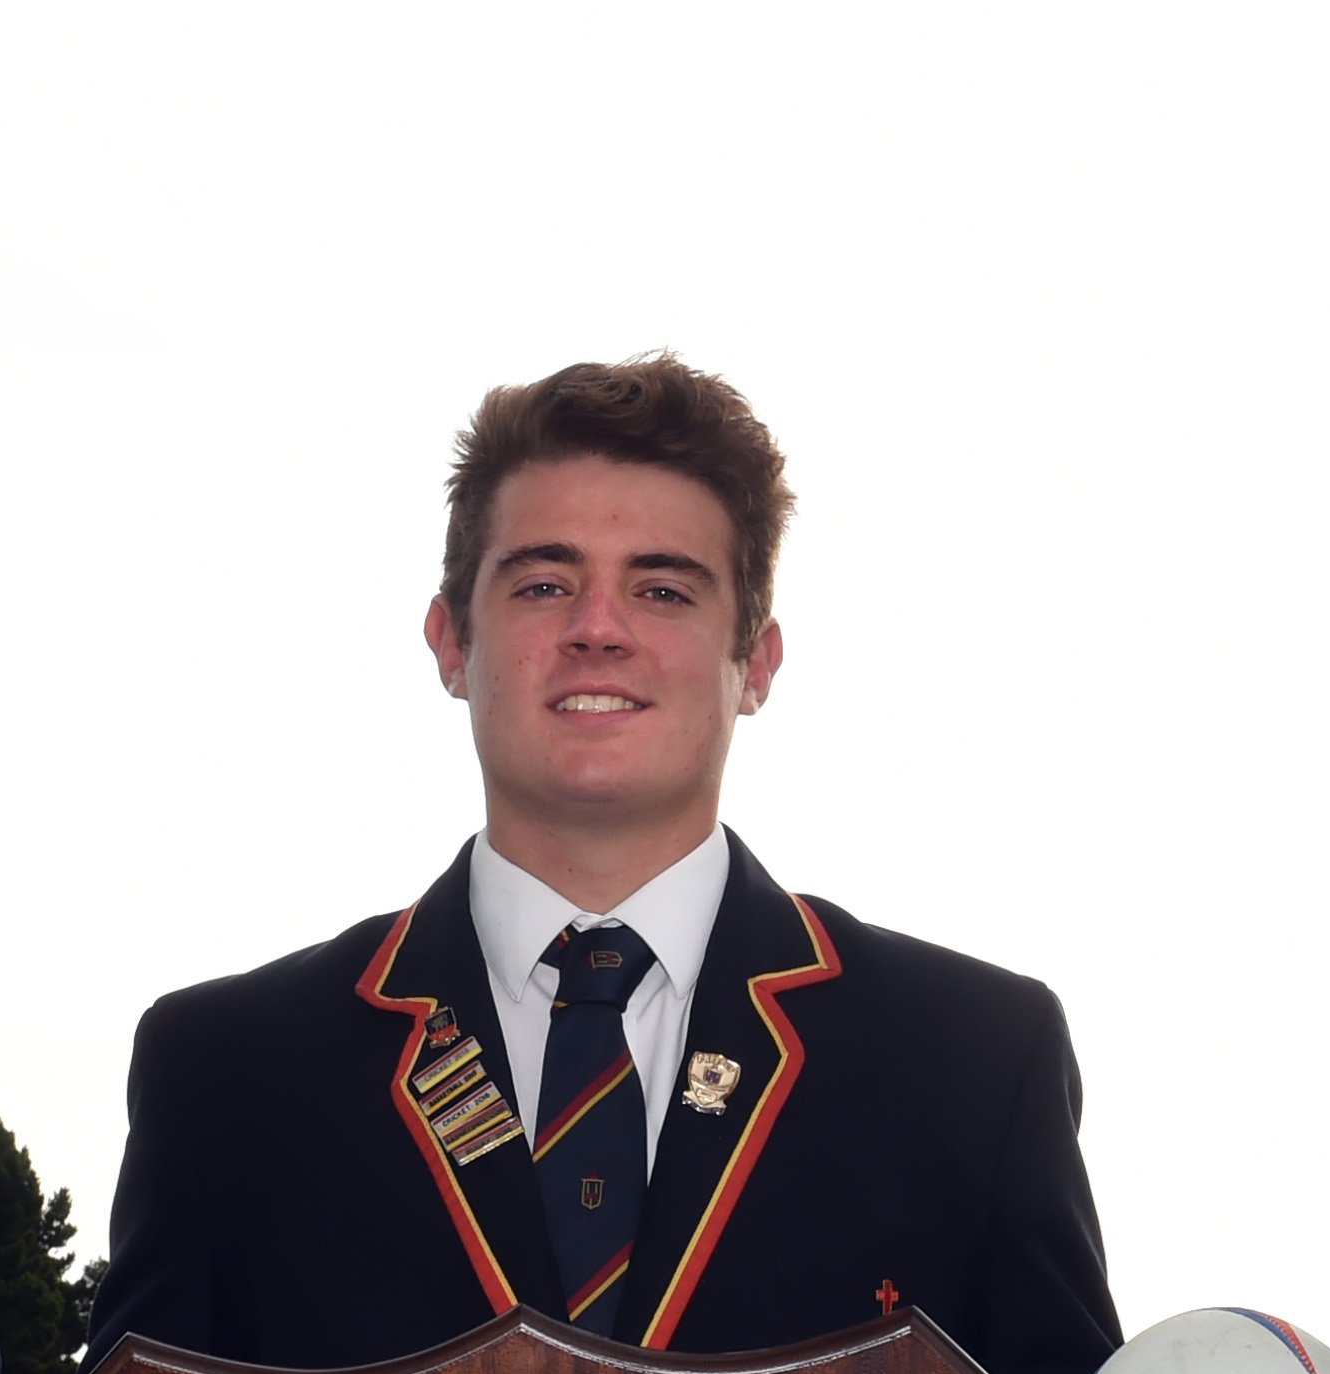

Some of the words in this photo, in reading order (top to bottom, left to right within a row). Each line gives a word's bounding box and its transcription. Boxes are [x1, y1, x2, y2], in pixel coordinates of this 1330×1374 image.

[424, 1057, 452, 1082] CRICKET
[442, 1101, 471, 1127] CRICKET
[474, 1093, 491, 1107] 2016
